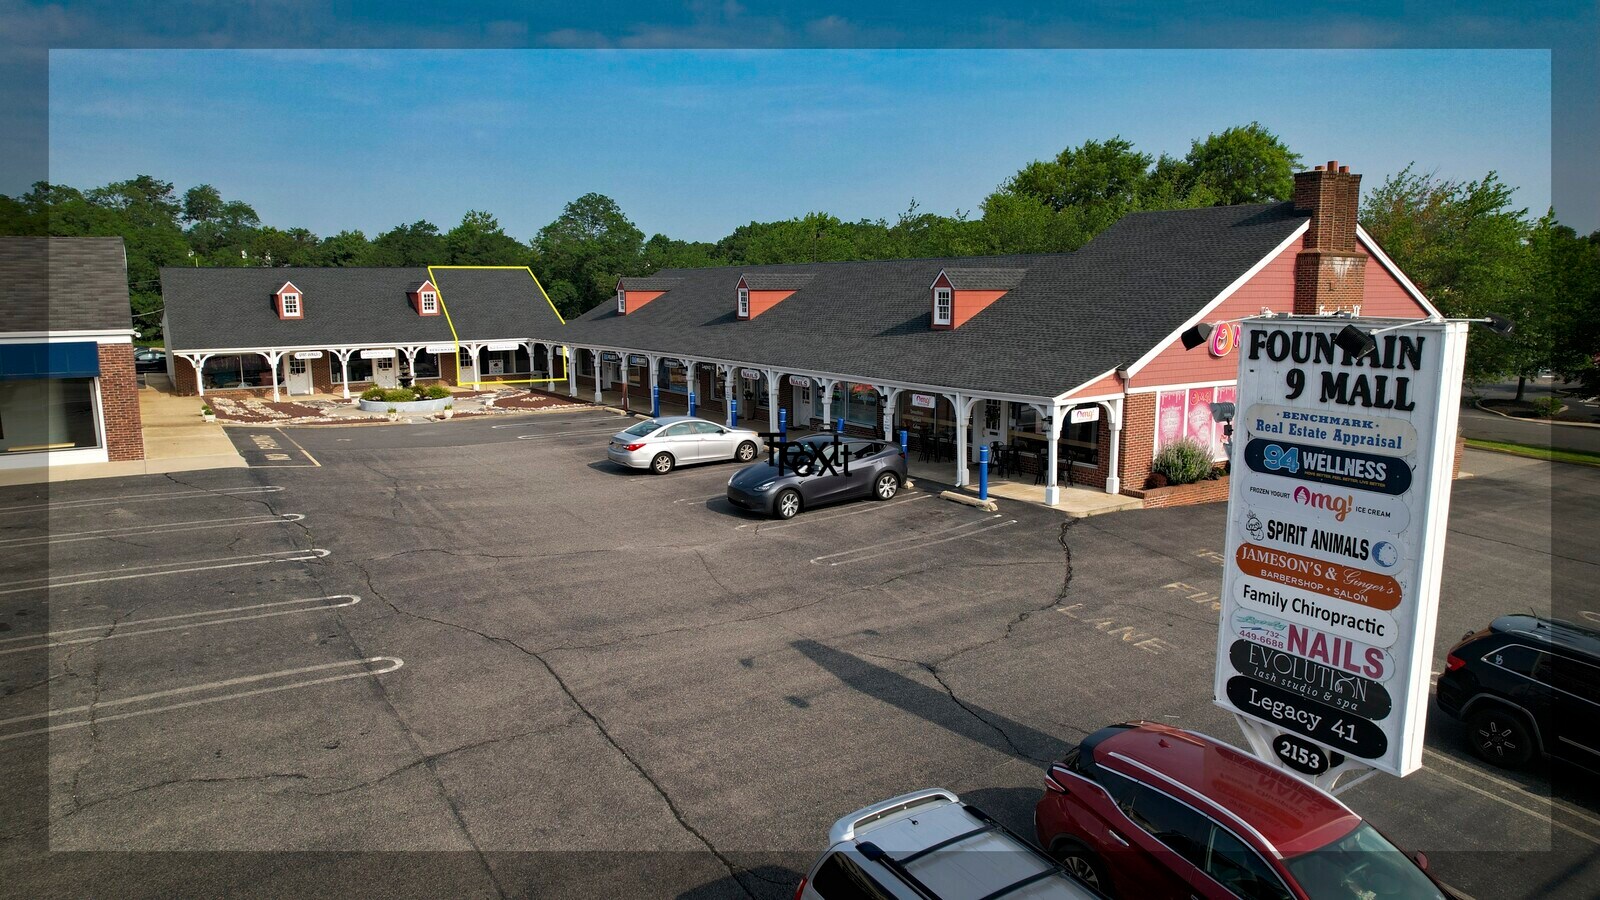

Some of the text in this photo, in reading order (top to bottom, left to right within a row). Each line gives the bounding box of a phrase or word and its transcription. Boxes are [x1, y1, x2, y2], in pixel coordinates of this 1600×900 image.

[1249, 330, 1425, 370] FOUNAIN
[1285, 368, 1416, 412] 9 MALL
[1256, 419, 1402, 449] Real Estate Appraisal
[1283, 411, 1373, 429] BENCHMARK
[1263, 444, 1386, 481] 94 WELLNESS
[1250, 486, 1290, 499] FROZEN YOGURT
[1368, 508, 1391, 518] CREAM
[1267, 520, 1369, 561] SPIRIT ANIMALS
[1242, 546, 1322, 577] JAMESON'S
[1325, 567, 1338, 580] &
[1343, 569, 1394, 594] Ginger's
[1261, 569, 1323, 590] BARBERSHOP
[1334, 588, 1368, 603] SALON
[1243, 584, 1384, 636] Family Chiropractic
[1240, 630, 1284, 649] 449-6688
[1266, 630, 1279, 638] 732
[1287, 624, 1384, 680] NAILS
[1253, 667, 1358, 711] lash studio & spa
[1249, 688, 1358, 743] Legacy 41
[1280, 741, 1319, 769] 2153
